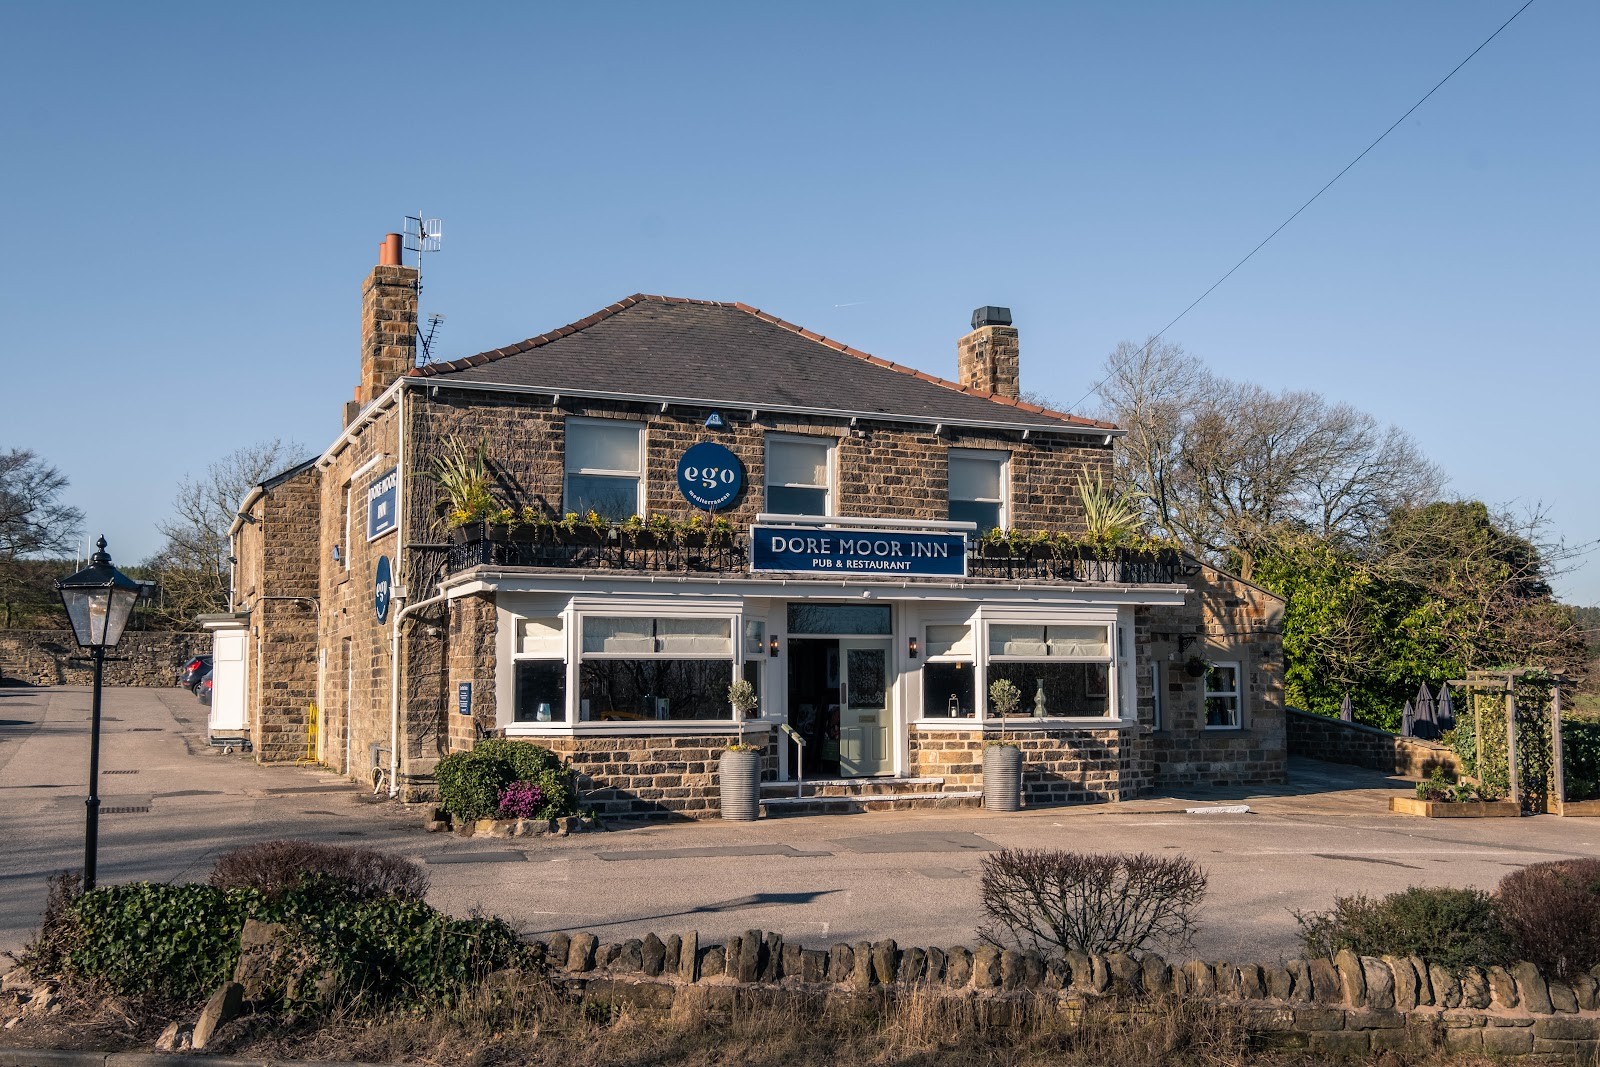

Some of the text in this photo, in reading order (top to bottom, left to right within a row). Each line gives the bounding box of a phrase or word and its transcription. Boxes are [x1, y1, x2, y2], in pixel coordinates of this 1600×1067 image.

[684, 466, 735, 489] ego
[688, 490, 731, 505] mediterranean
[771, 536, 948, 558] DORE MOOR INN
[812, 558, 911, 570] PUB & RESTAURANT
